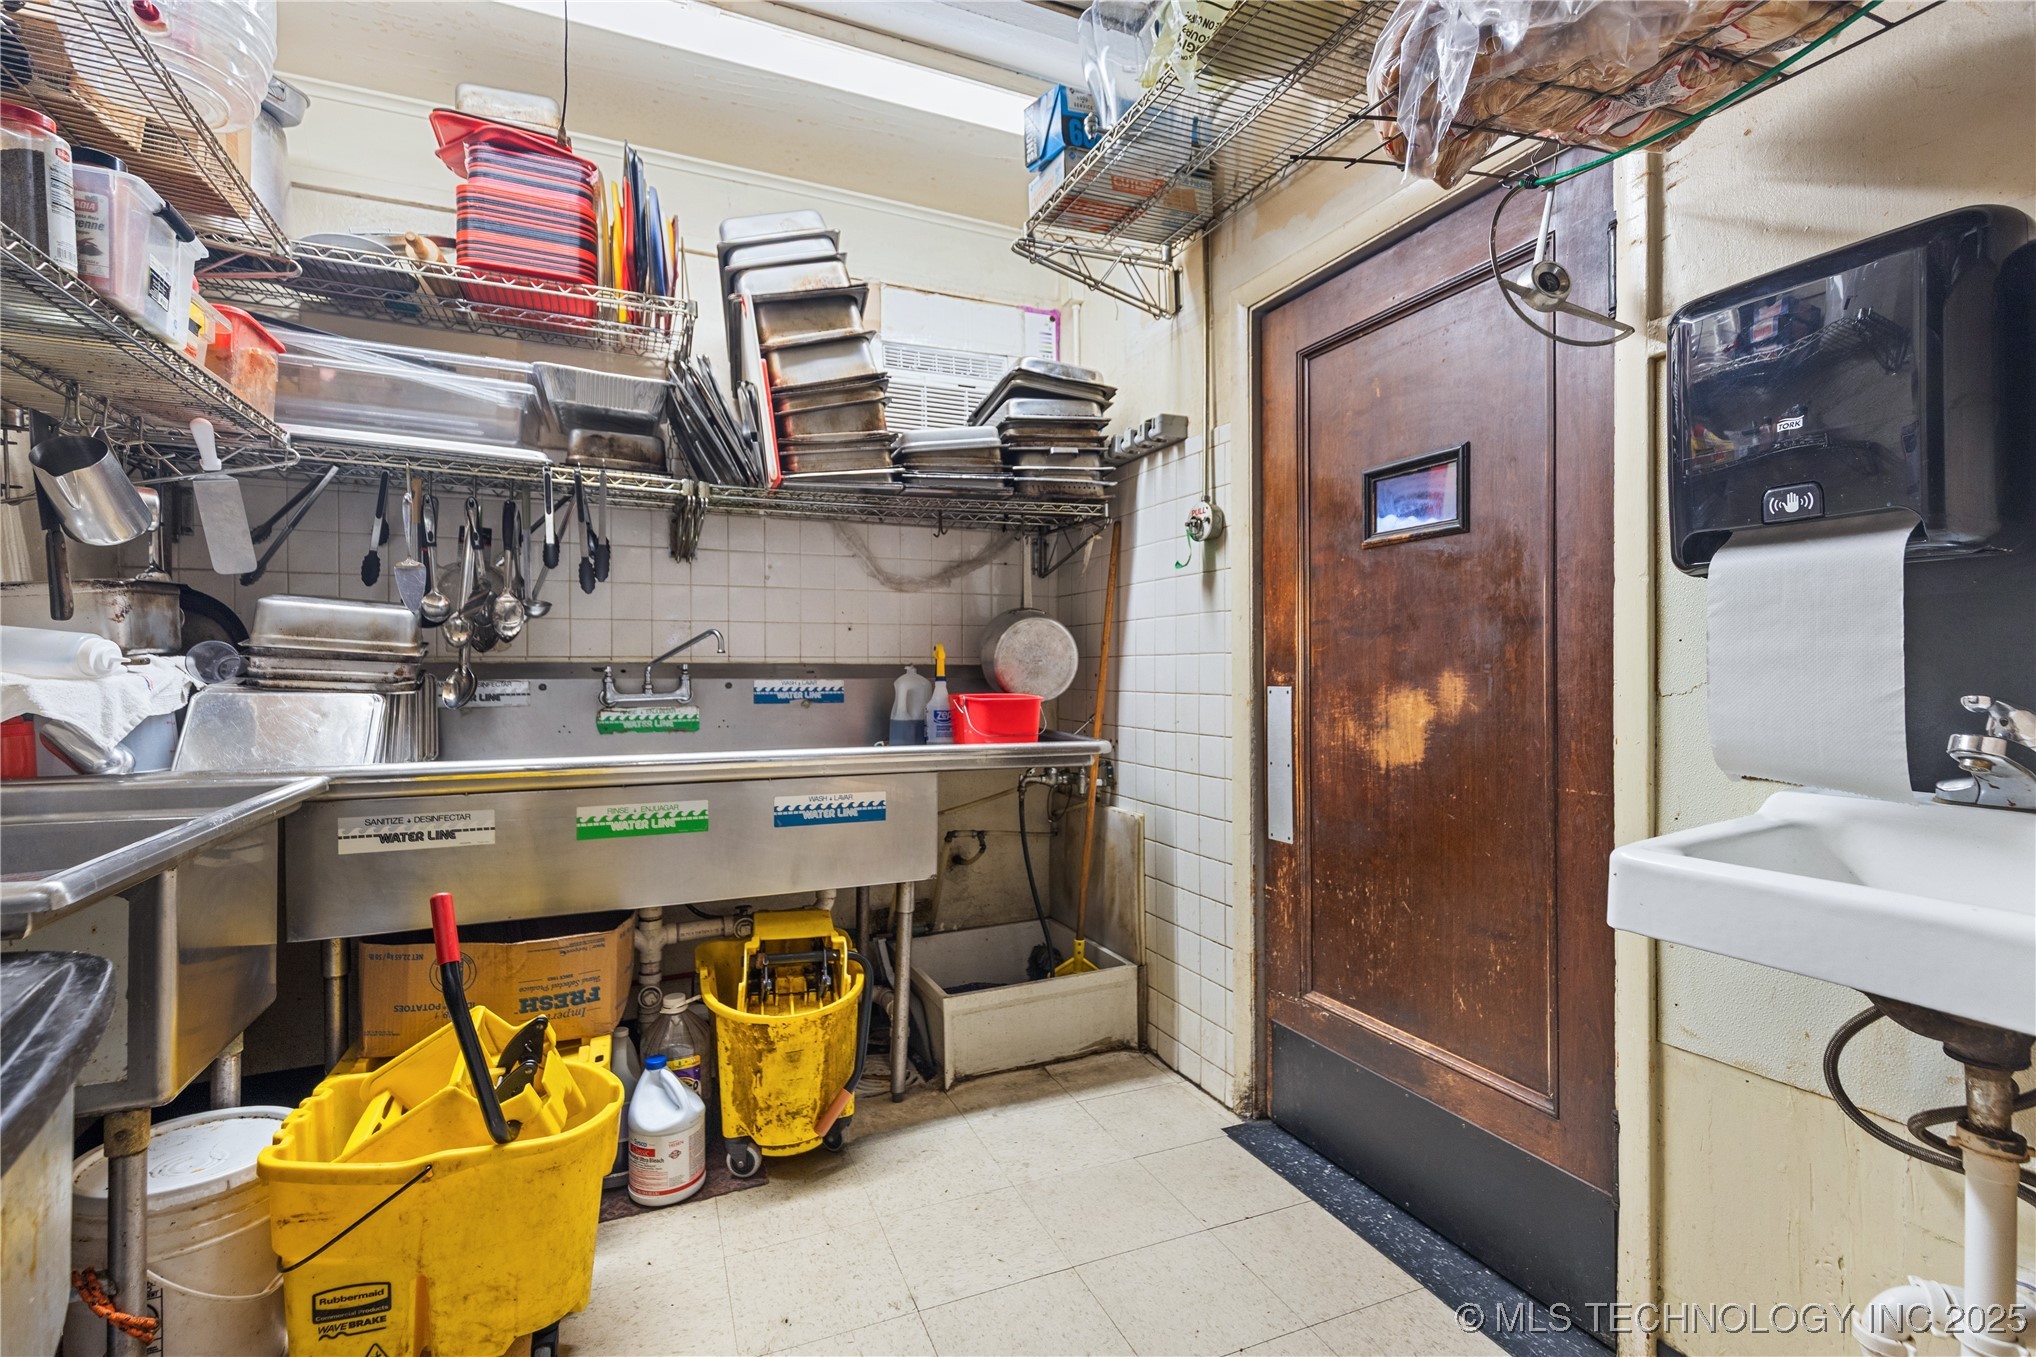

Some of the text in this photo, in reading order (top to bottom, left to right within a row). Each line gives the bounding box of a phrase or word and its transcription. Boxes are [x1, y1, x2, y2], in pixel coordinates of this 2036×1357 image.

[1779, 421, 1801, 430] TORK
[1191, 507, 1206, 516] PULL
[607, 804, 680, 814] RINSE ENJUAGAR
[802, 807, 858, 820] WATER LINE
[364, 813, 472, 826] SANITIZE DESINFECTAR
[610, 818, 677, 831] WATER LINE
[379, 829, 457, 844] WATER LINE
[518, 985, 550, 993] Produce
[551, 980, 580, 990] Selected
[518, 986, 601, 1014] FRESH
[393, 1002, 441, 1013] POTATOES
[319, 1288, 385, 1306] Rubbermaid
[315, 1305, 389, 1322] Commercial Products
